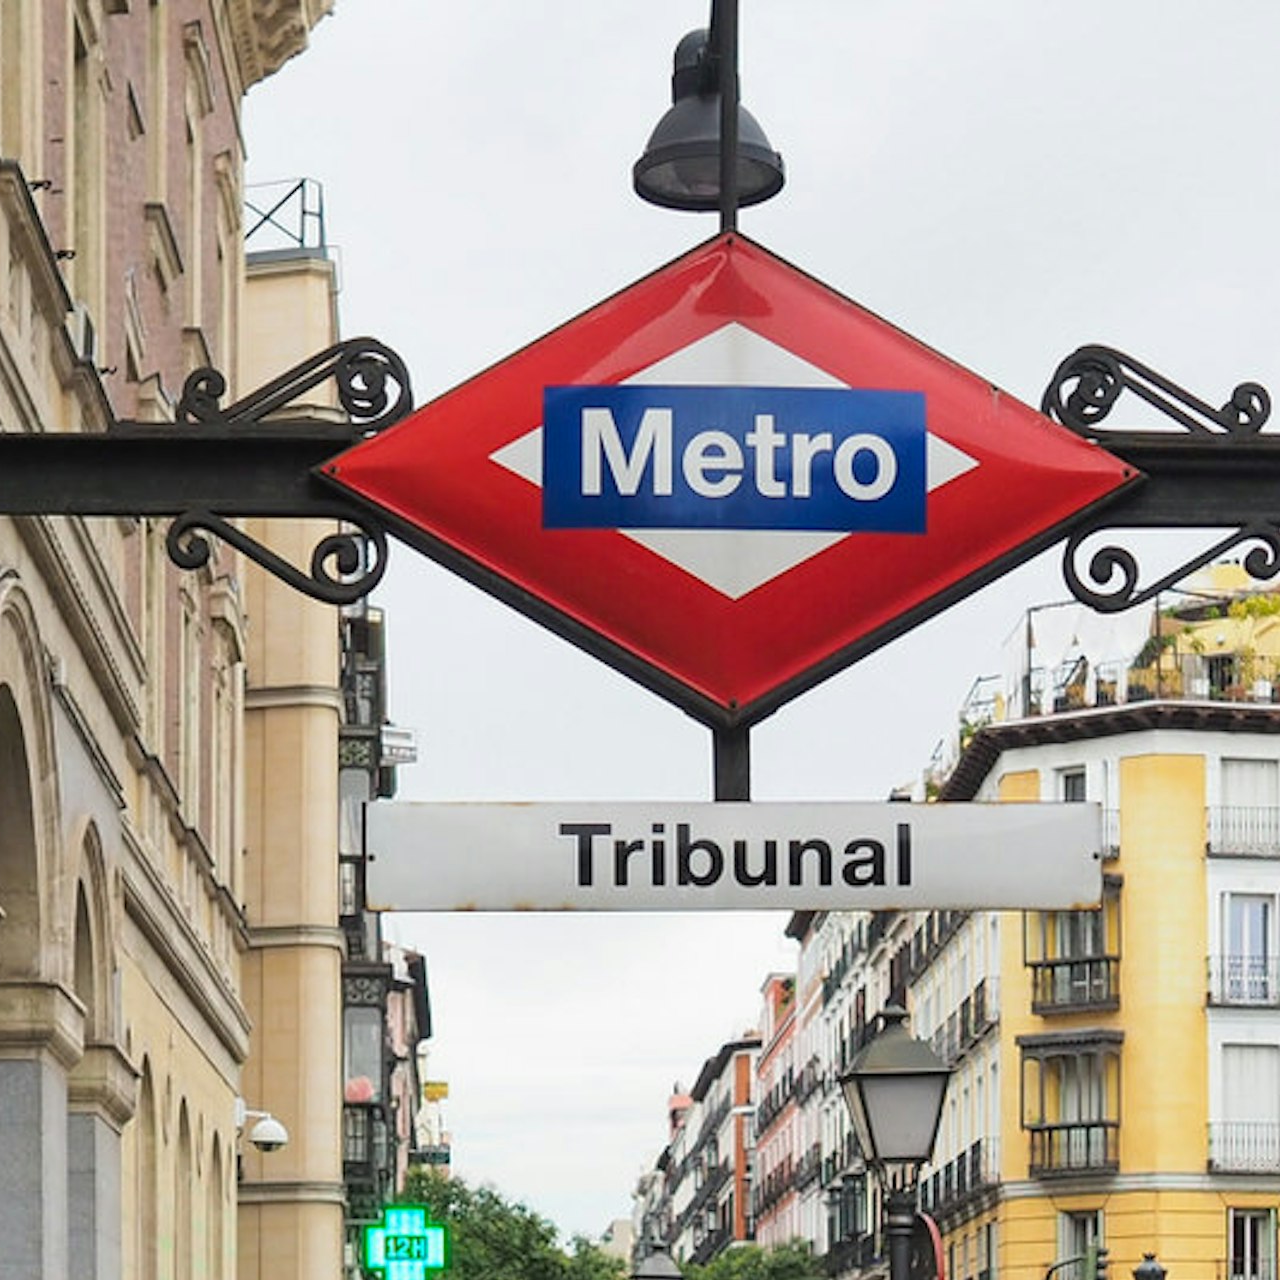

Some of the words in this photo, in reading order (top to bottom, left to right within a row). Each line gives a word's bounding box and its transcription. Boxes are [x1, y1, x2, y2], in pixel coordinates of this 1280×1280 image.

[581, 407, 898, 501] Metro
[559, 822, 913, 888] Tribunal
[387, 1237, 425, 1258] 12H
